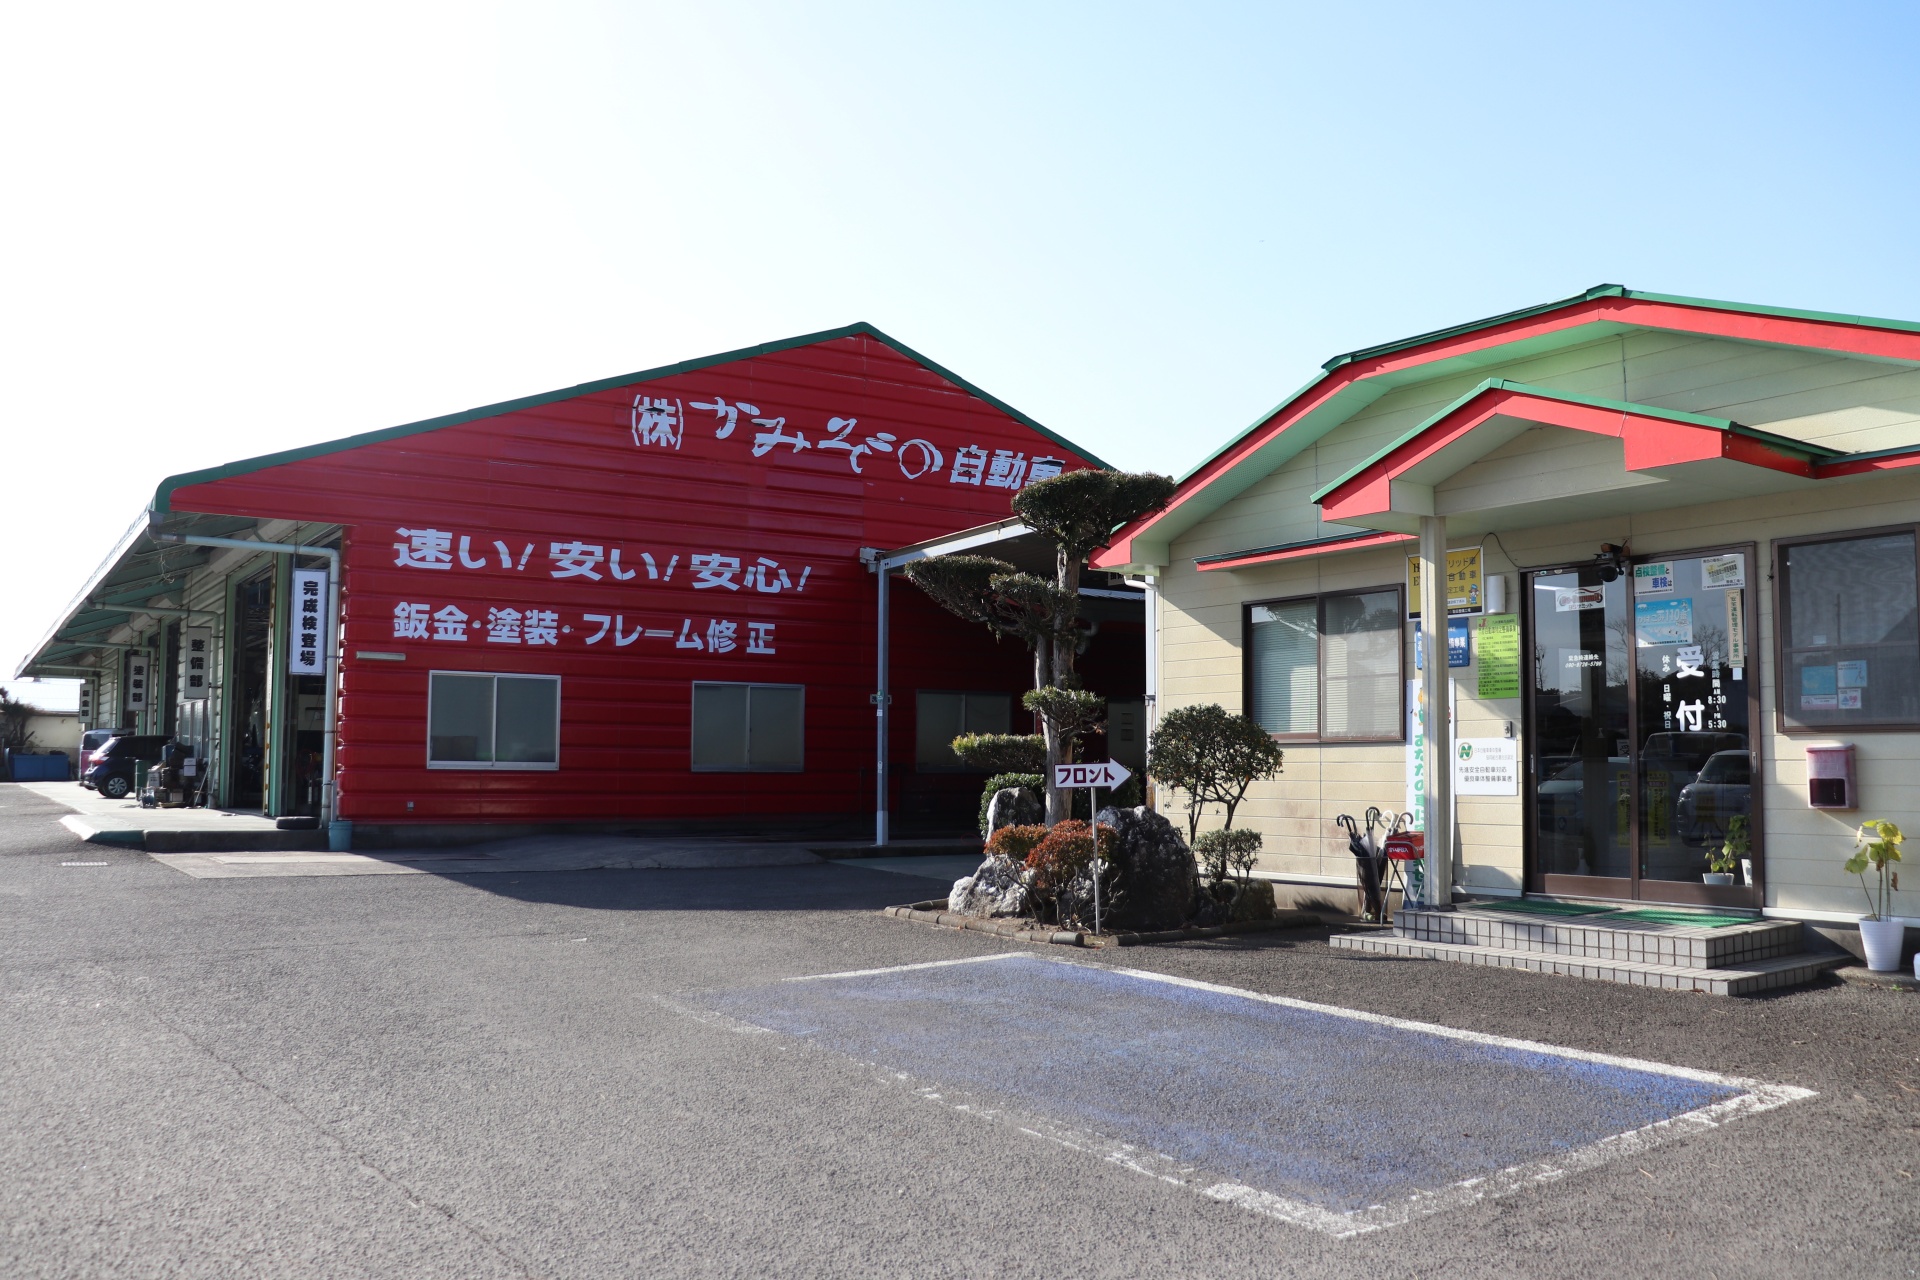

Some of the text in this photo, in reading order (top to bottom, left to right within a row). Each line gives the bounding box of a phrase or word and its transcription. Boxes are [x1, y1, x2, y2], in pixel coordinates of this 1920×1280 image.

[393, 527, 812, 593] 速い! 安い! 安心!
[1635, 564, 1670, 578] 点検整備と
[1651, 577, 1673, 589] 車検は
[300, 580, 319, 666] 完成検査場
[393, 602, 775, 654] 鈑金・塗装・フレーム修正
[189, 639, 205, 688] 整備部
[1662, 655, 1671, 672] 休み
[132, 665, 145, 703] 塗装部
[1676, 646, 1705, 732] 受付
[1663, 684, 1672, 729] 日曜・祝日
[1707, 695, 1727, 705] 8:30
[1708, 720, 1727, 728] 5:30
[1057, 767, 1116, 784] フロント
[1458, 766, 1507, 774] 先進安全自動車対応
